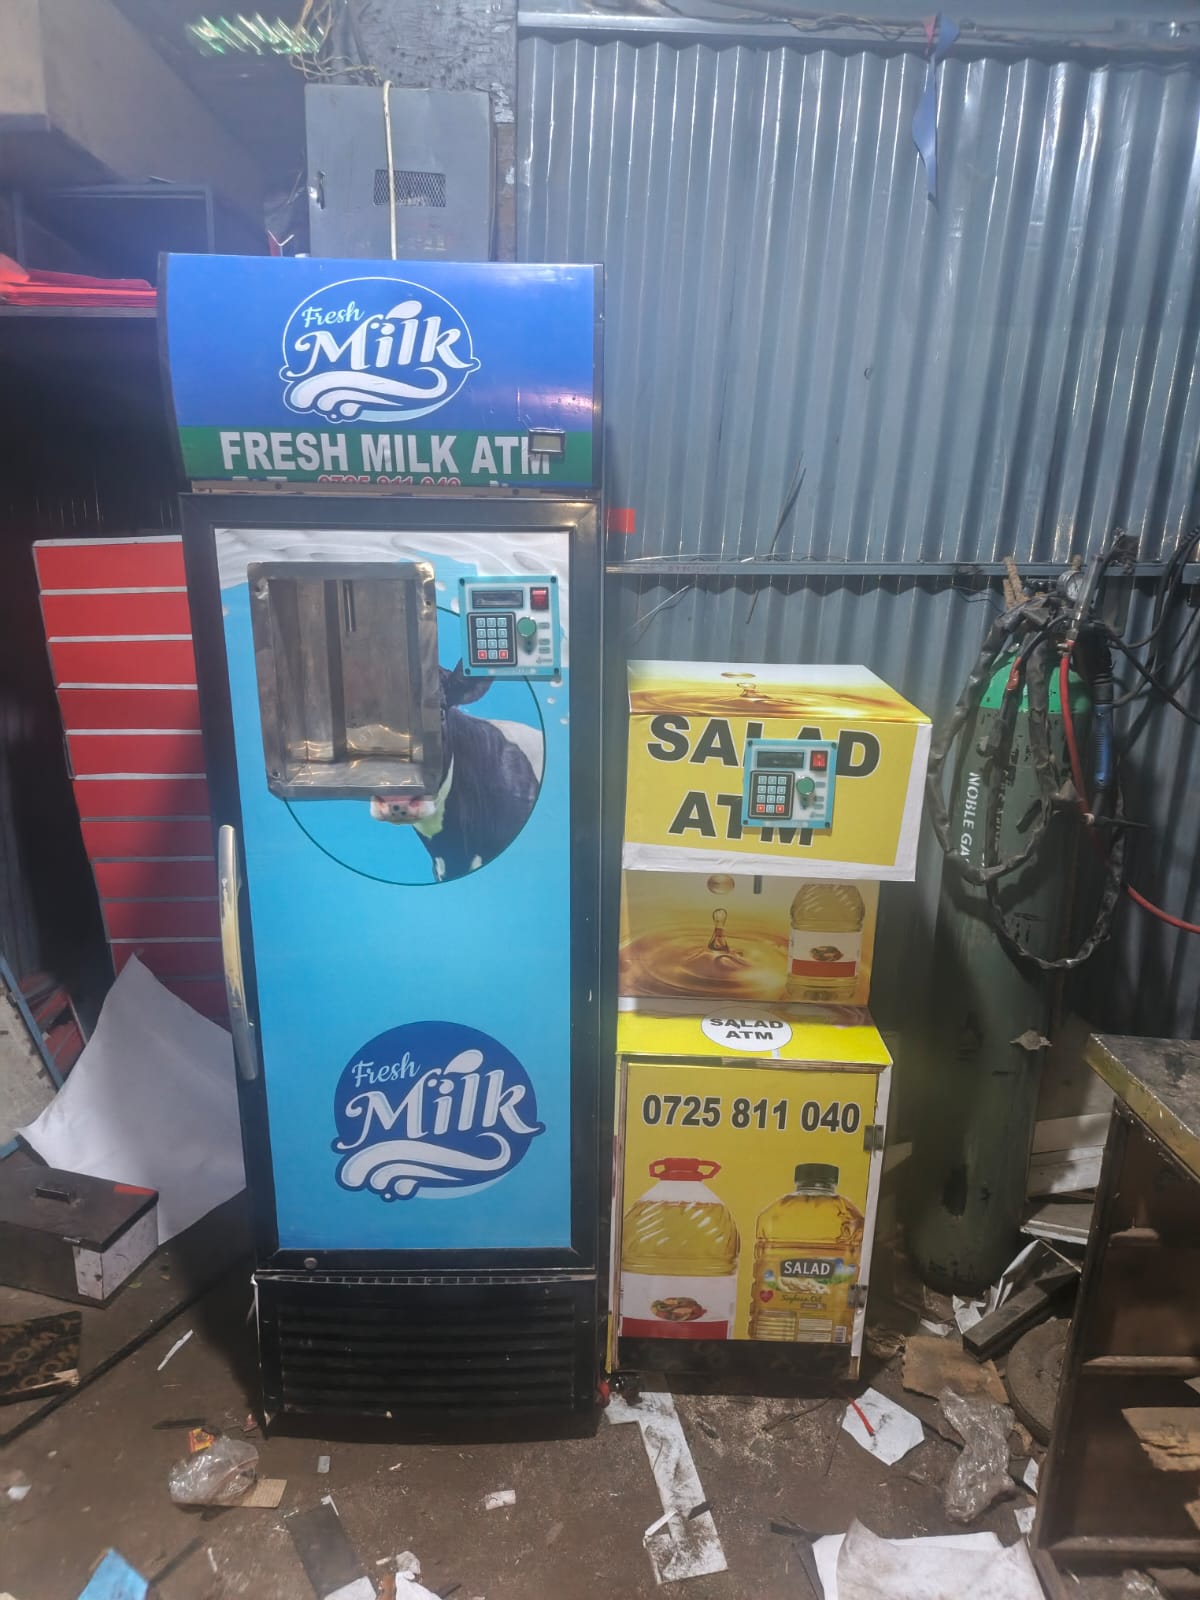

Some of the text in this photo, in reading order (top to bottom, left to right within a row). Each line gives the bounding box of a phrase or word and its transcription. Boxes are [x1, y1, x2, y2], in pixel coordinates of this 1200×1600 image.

[301, 300, 364, 328] Fresh
[286, 310, 474, 378] Milk
[219, 430, 550, 475] FRESH MILK ATM
[647, 713, 882, 778] SAD
[959, 771, 981, 864] NOBLE GA
[709, 1017, 785, 1031] SALAD
[725, 1030, 775, 1041] ATM
[351, 1051, 421, 1088] Fresh
[336, 1065, 541, 1150] Milk
[642, 1094, 861, 1134] 0725 811 040
[783, 1261, 831, 1275] SALAD
